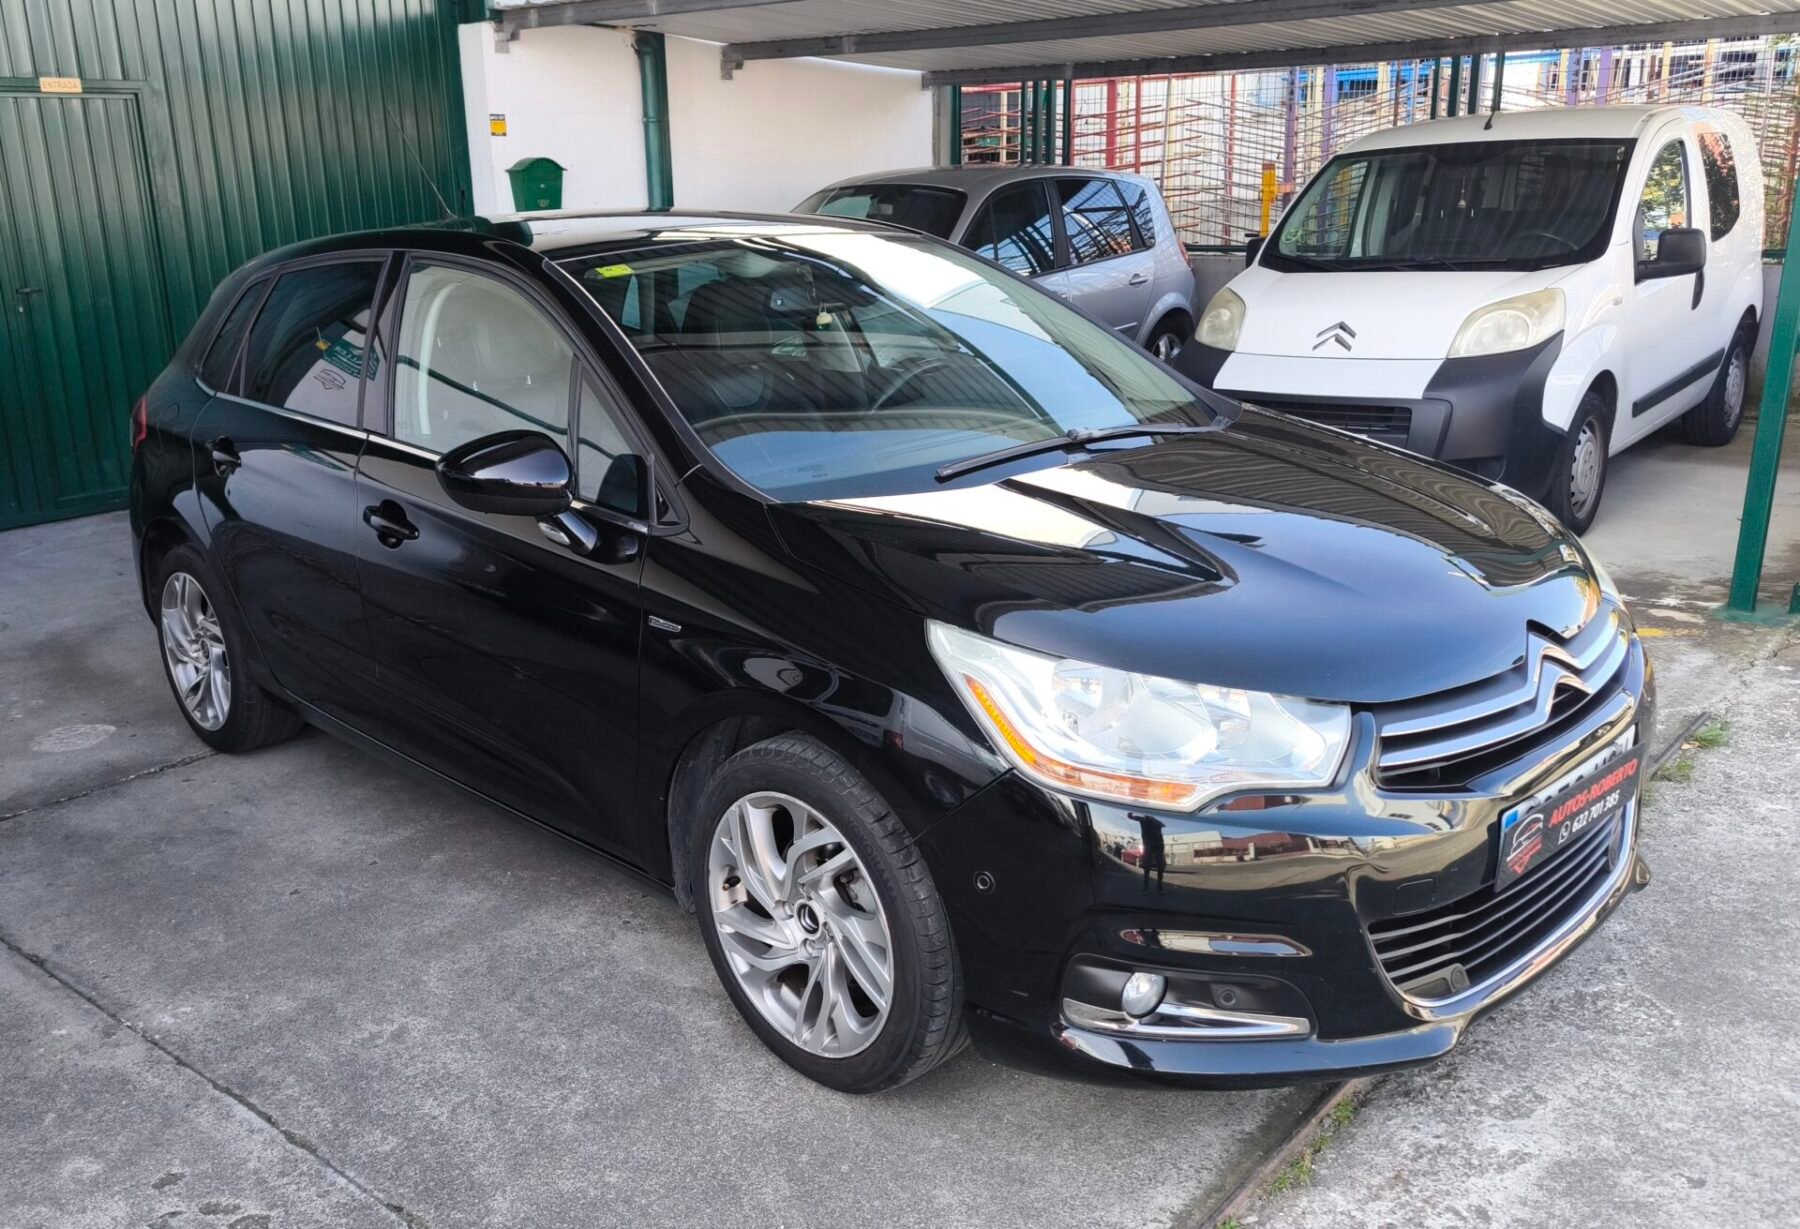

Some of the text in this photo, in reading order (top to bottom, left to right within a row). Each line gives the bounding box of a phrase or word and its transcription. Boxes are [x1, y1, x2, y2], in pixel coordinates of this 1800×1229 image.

[42, 80, 79, 89] ENTRADA
[1549, 758, 1638, 828] AUTOS-ROBERTO
[1572, 789, 1620, 833] 622 701 385
